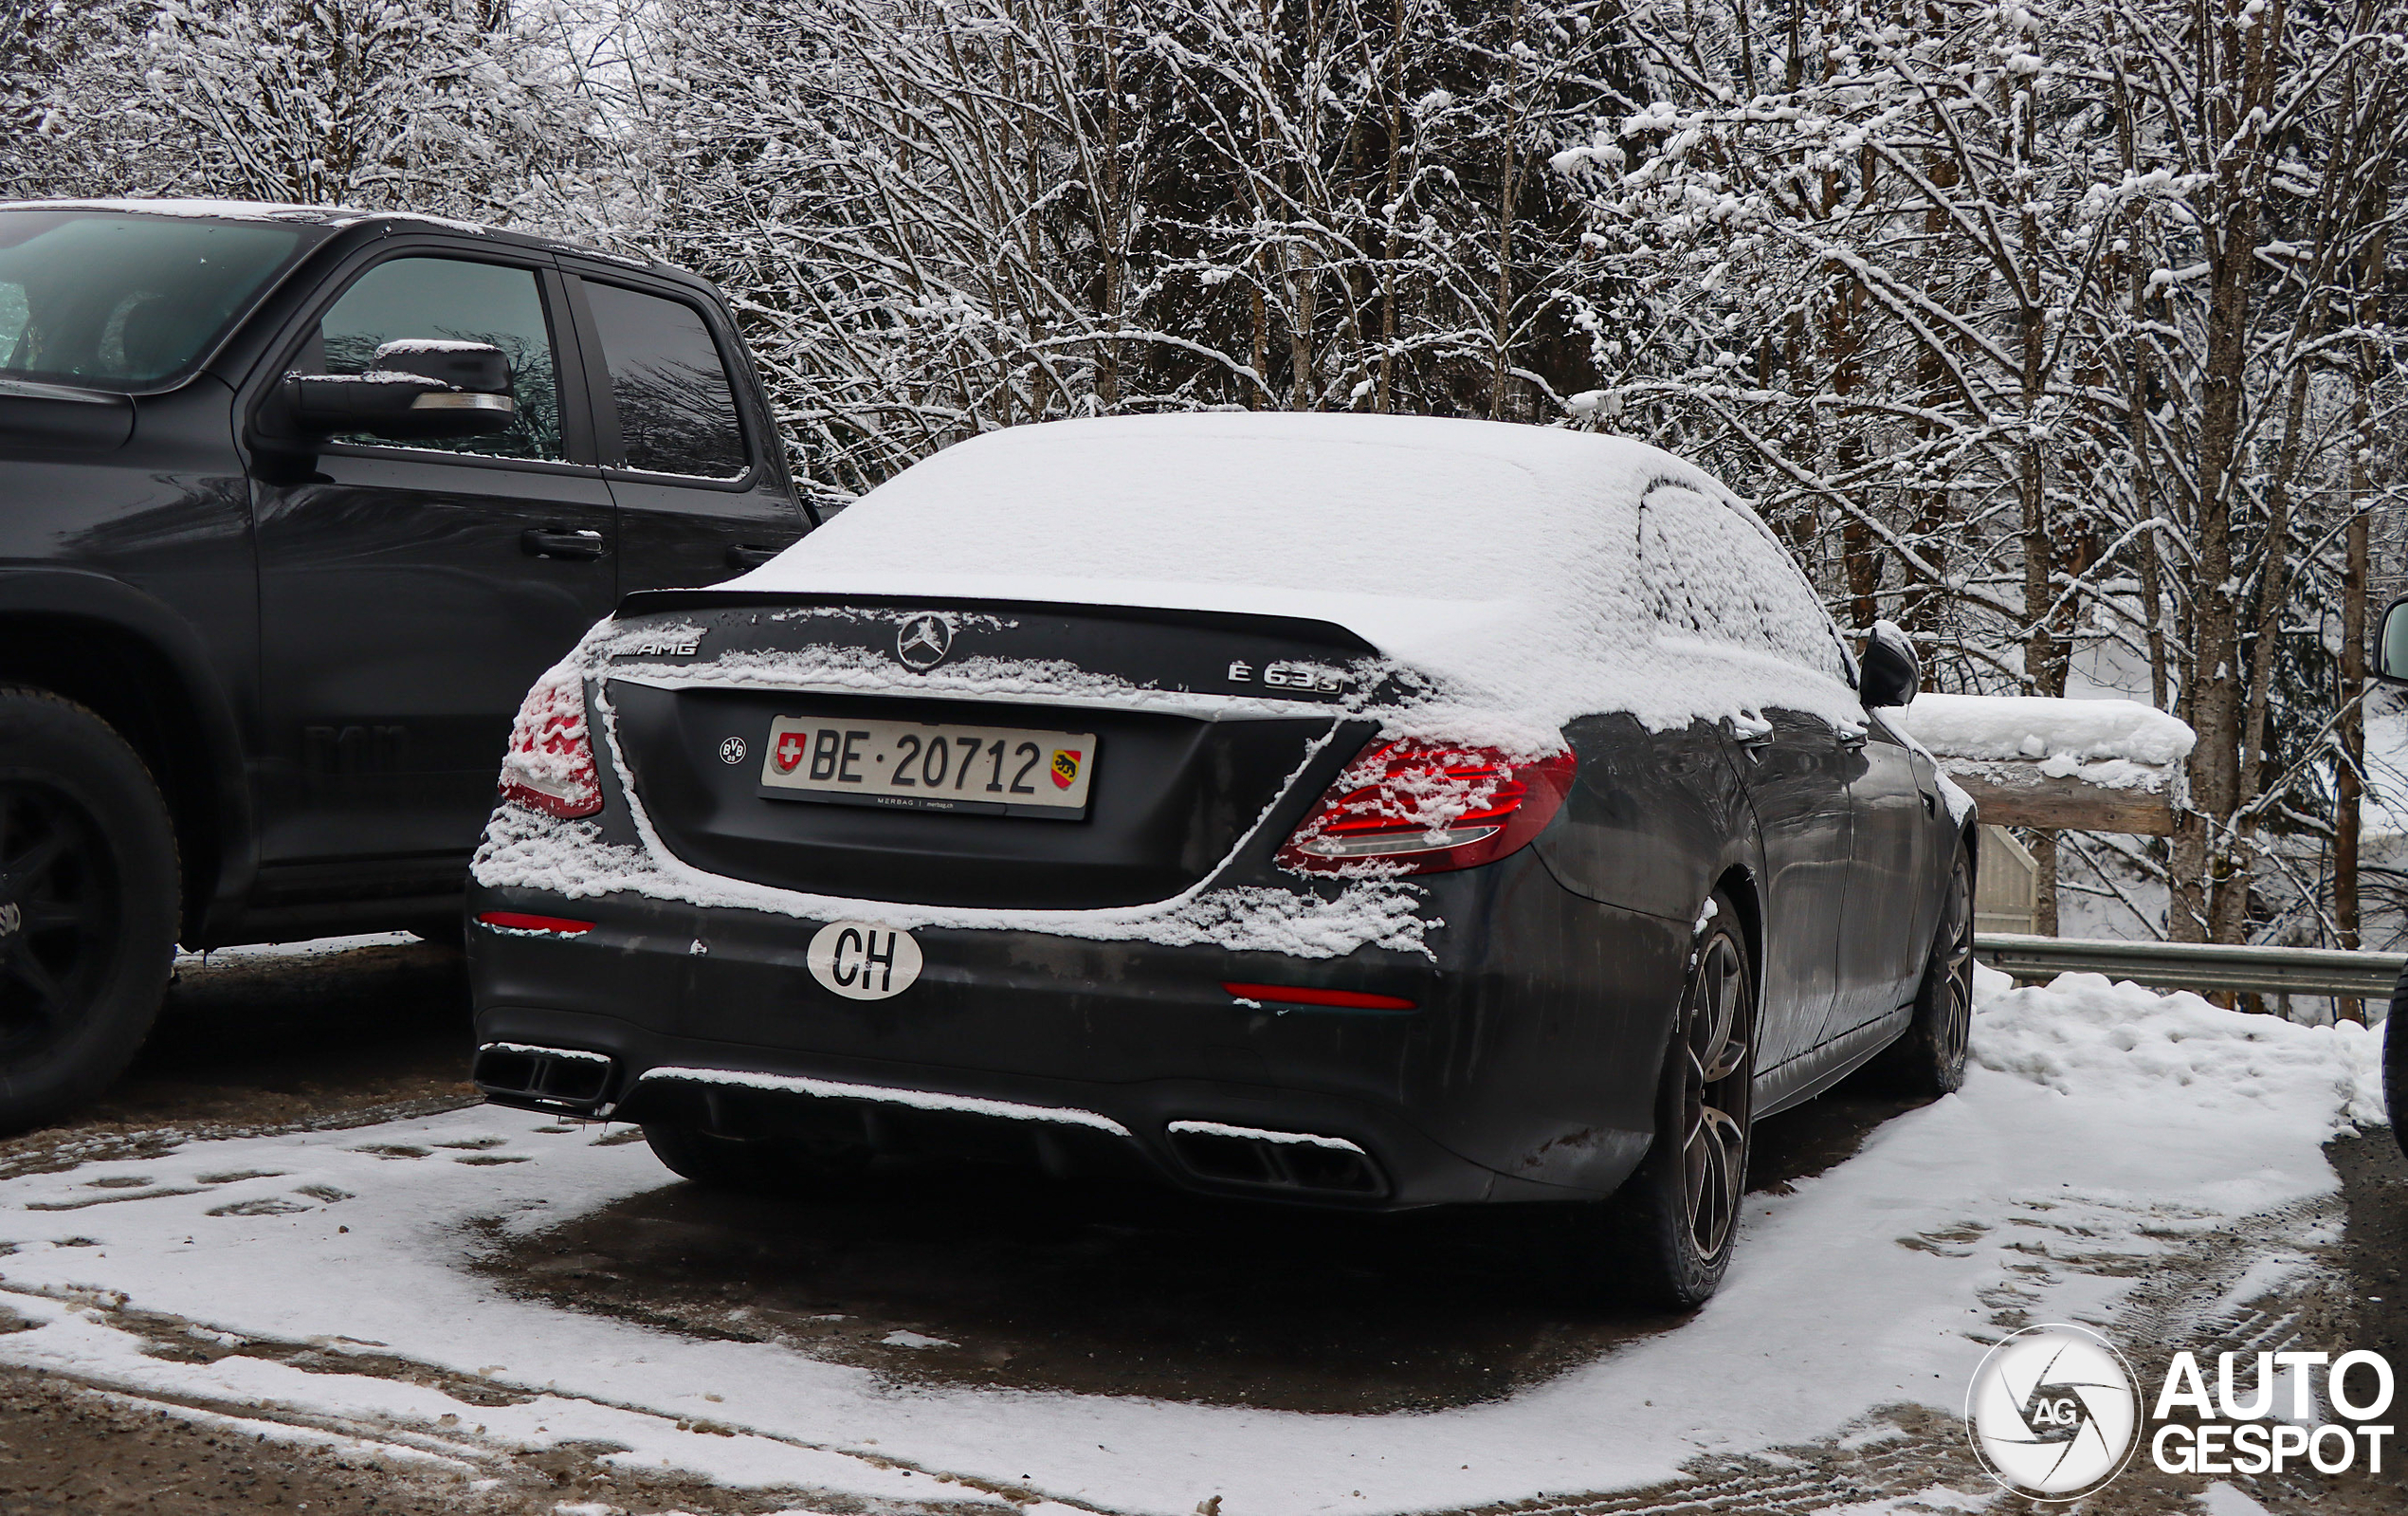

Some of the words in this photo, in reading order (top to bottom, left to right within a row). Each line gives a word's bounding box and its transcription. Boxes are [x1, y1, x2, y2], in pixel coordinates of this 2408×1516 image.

[1228, 663, 1253, 682] E
[722, 740, 744, 758] BVB
[877, 797, 914, 806] MERBAG
[832, 927, 896, 992] CH
